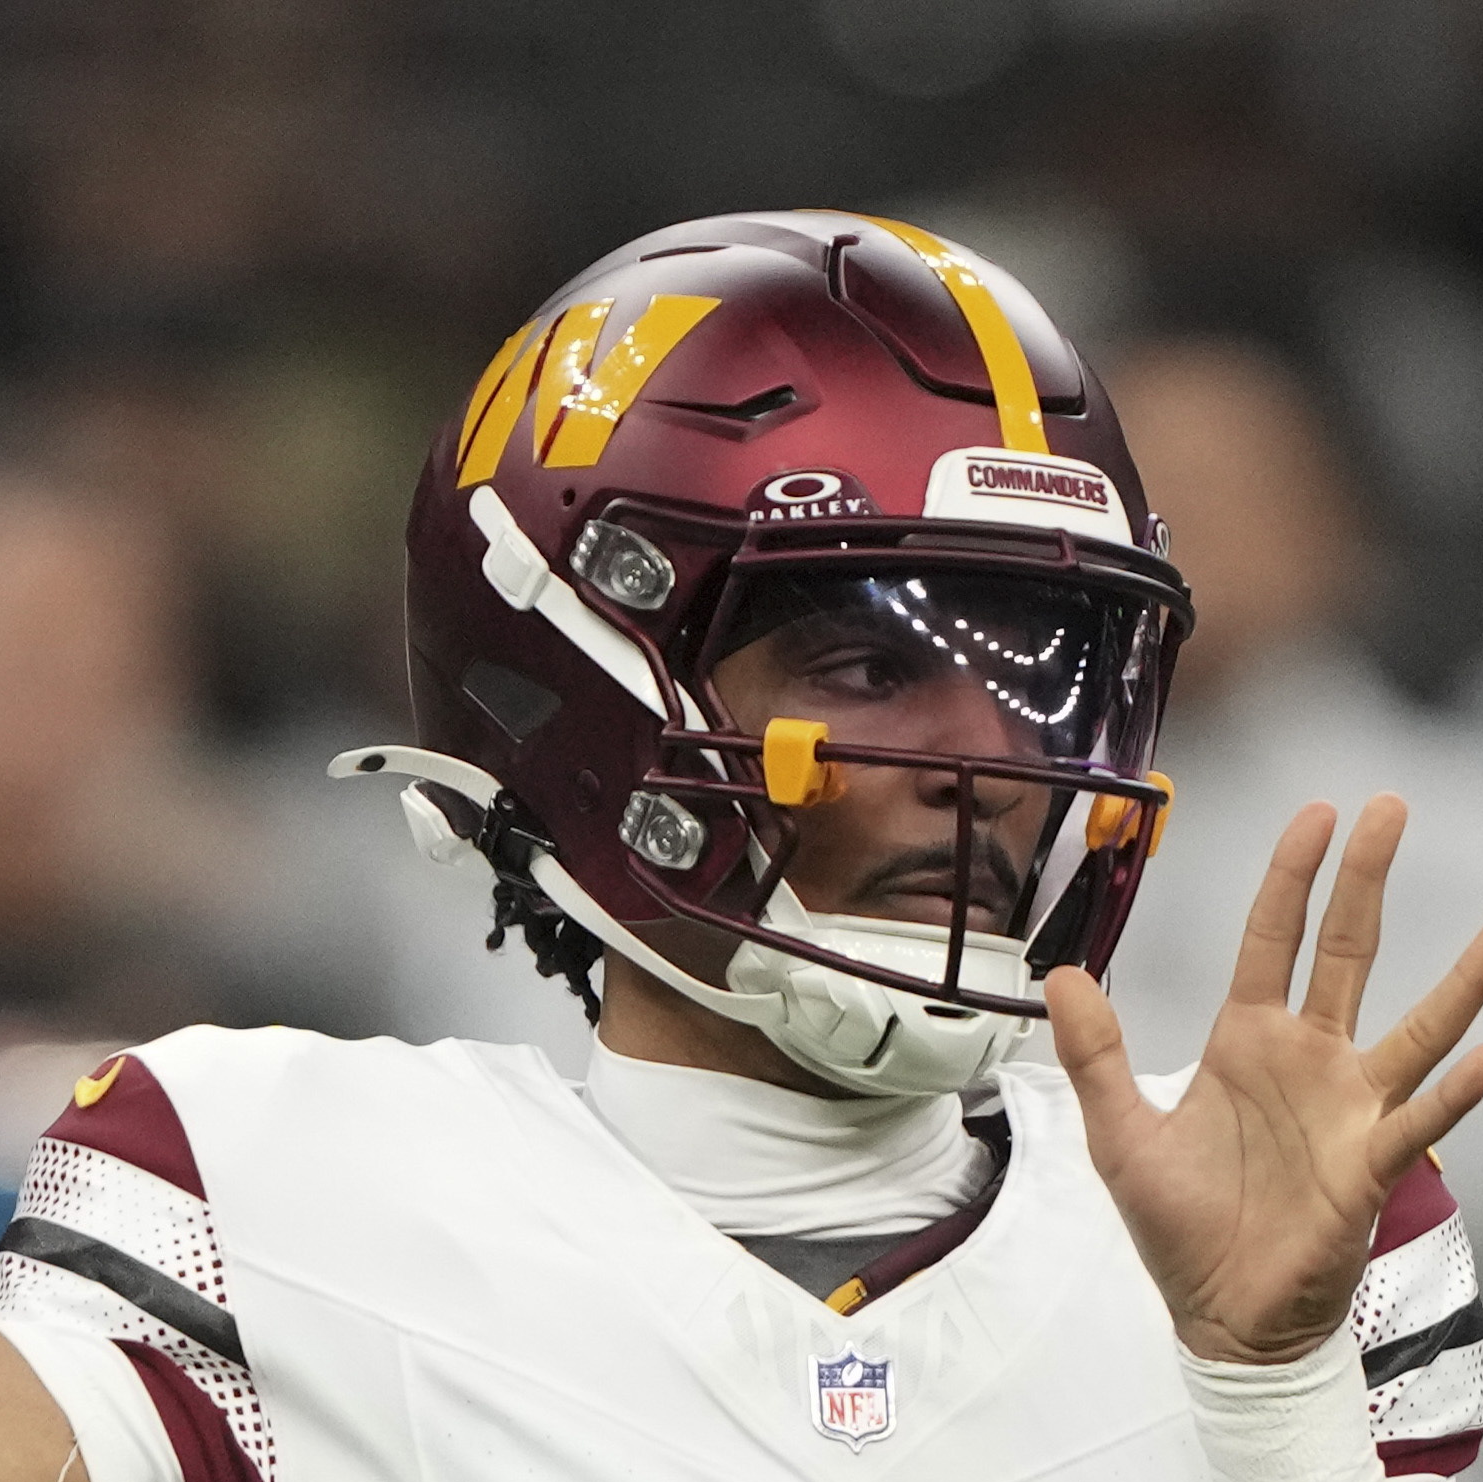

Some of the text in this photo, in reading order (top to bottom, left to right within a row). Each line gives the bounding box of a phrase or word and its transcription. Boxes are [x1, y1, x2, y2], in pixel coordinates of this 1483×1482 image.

[967, 463, 1108, 505] COMMANDERS
[749, 498, 870, 522] OAKLEY
[826, 1390, 883, 1430] NFL
